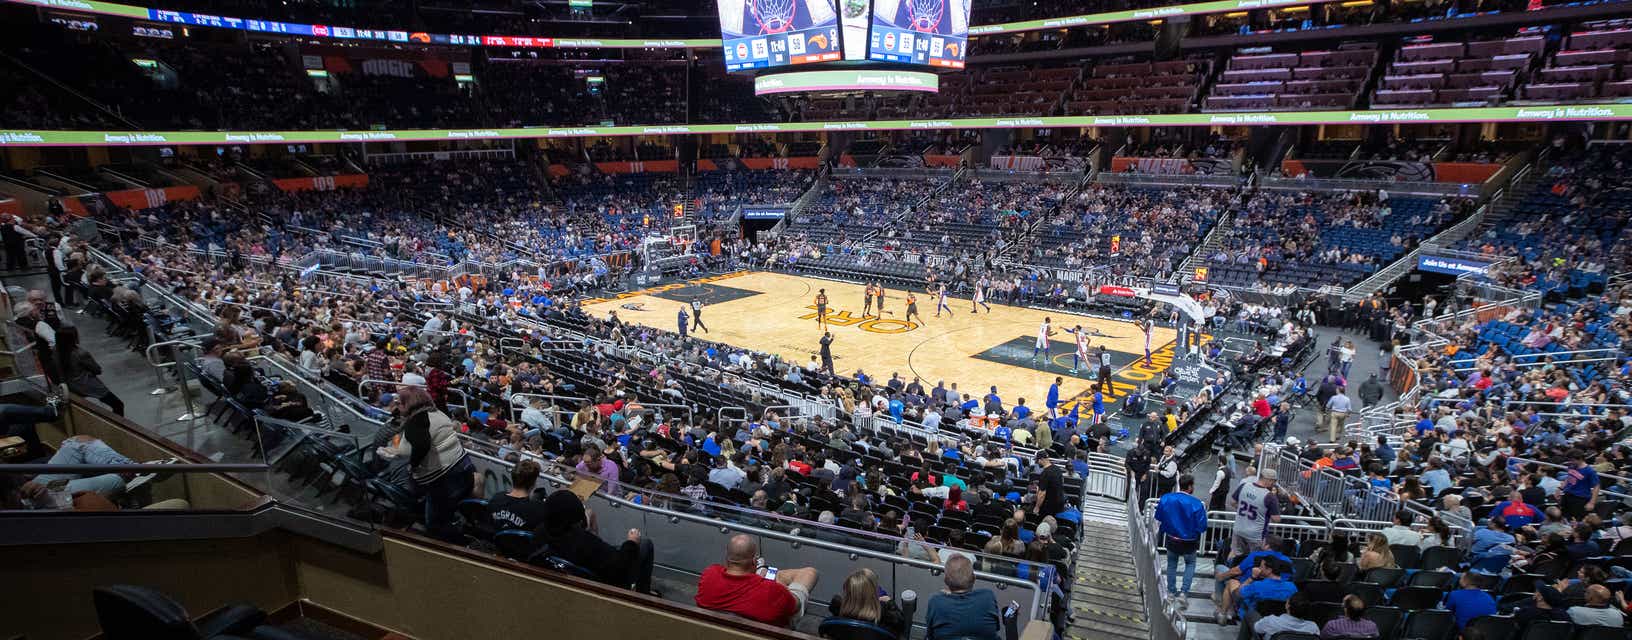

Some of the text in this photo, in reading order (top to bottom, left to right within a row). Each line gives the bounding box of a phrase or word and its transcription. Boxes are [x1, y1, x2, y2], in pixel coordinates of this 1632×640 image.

[362, 59, 415, 78] MAGIC
[1211, 115, 1235, 123] Amway
[1351, 113, 1379, 121] Amway
[1390, 112, 1428, 120] Nutrition.
[1517, 109, 1553, 119] Amway
[1567, 107, 1616, 118] Nutrition.
[630, 161, 643, 173] 111
[773, 158, 788, 169] 112
[145, 188, 167, 208] 108
[1423, 259, 1437, 267] Join
[1057, 270, 1083, 283] MAGIC
[1239, 500, 1258, 520] 25
